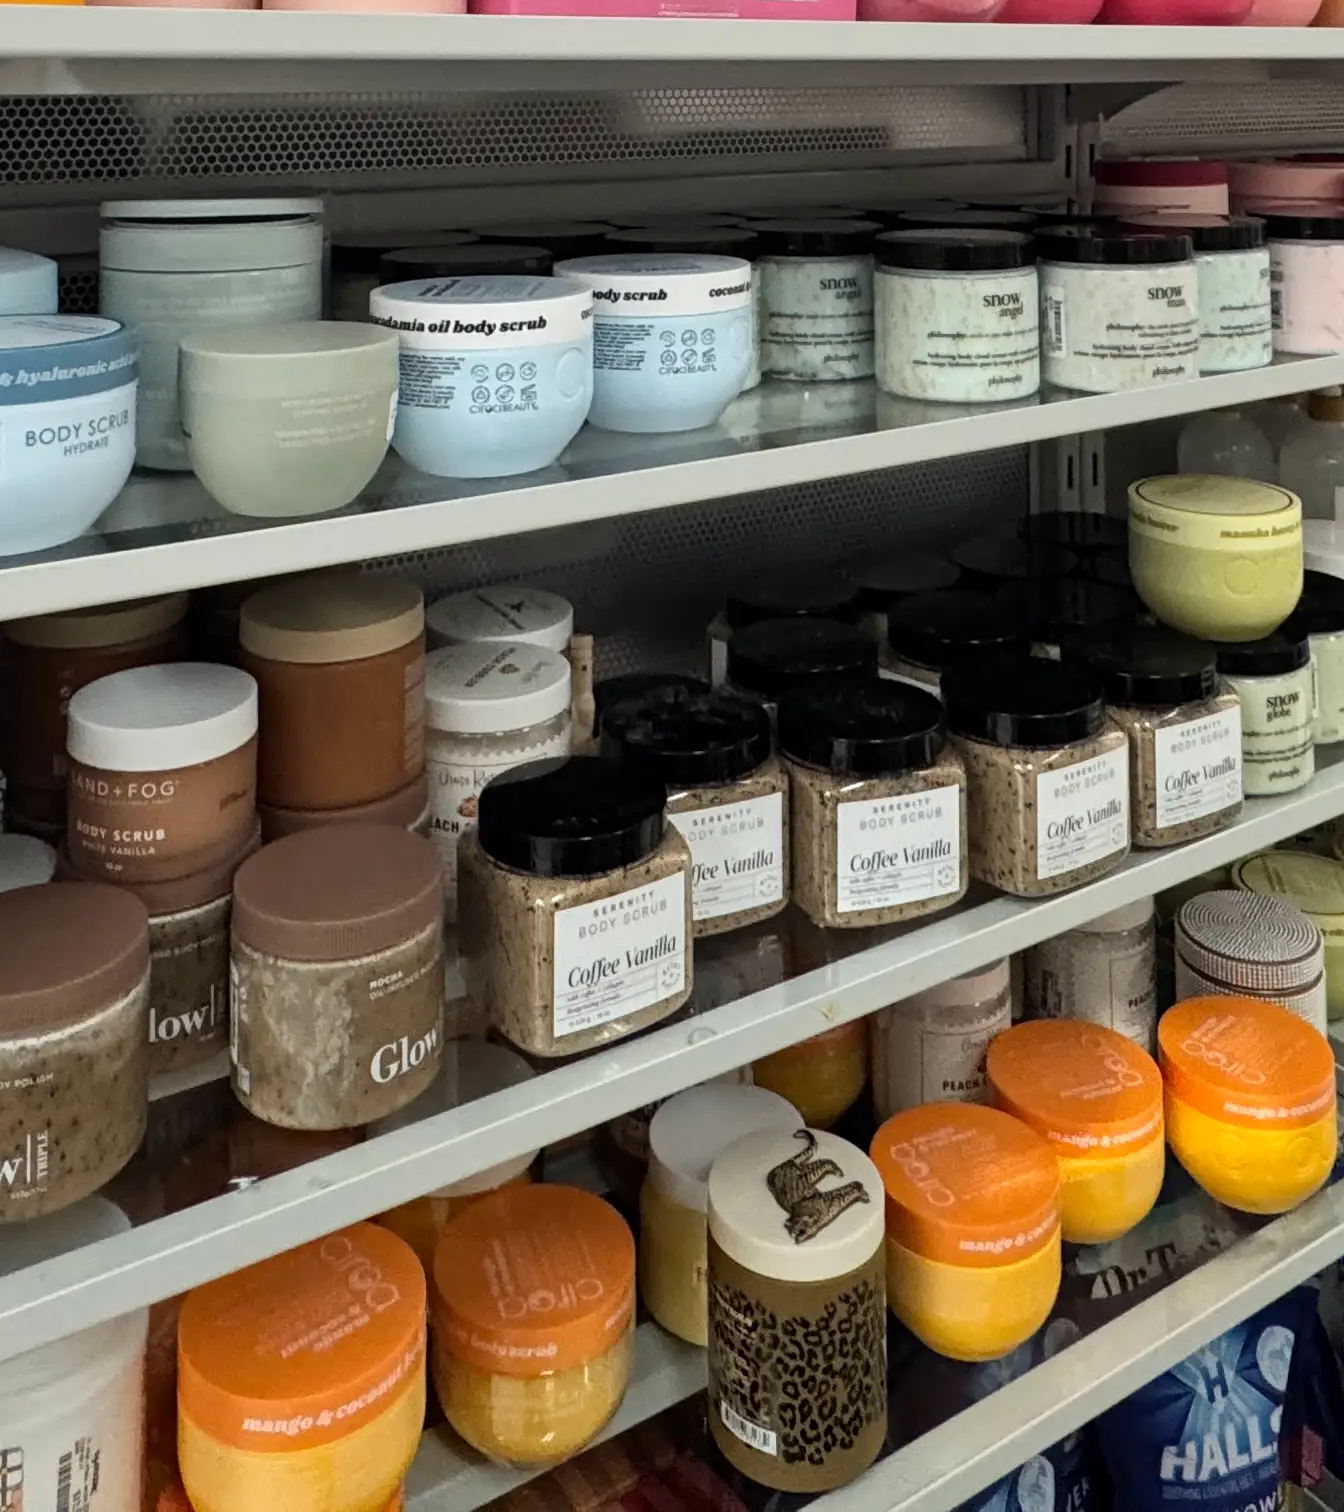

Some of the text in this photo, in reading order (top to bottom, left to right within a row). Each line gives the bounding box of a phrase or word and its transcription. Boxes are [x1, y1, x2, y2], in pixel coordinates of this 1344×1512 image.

[818, 276, 859, 292] snow
[1146, 285, 1186, 301] snow
[621, 287, 669, 304] scrub
[982, 291, 1023, 309] snow
[997, 303, 1025, 319] angel
[428, 315, 548, 337] oil body scrub
[15, 358, 109, 390] hyaluronic
[23, 408, 131, 449] BODY SCRUB
[62, 435, 111, 457] HYDRATE
[1266, 692, 1301, 711] snow
[1265, 706, 1294, 723] globe
[1163, 755, 1237, 794] Coffee Vanilla
[127, 779, 176, 798] FOG
[871, 797, 932, 815] SERENITY
[858, 815, 895, 830] BODY
[1046, 796, 1123, 843] Coffee Vanilla
[113, 827, 167, 842] SCRUB
[109, 843, 157, 856] VANILLA
[849, 838, 953, 874] Coffee Vanilla
[723, 847, 775, 878] Vanilla
[591, 890, 656, 919] SERENITY
[577, 917, 618, 940] BODY
[567, 933, 678, 991] Coffee Vanilla
[369, 969, 404, 990] MOCHA
[369, 1030, 438, 1085] Glow
[942, 1078, 981, 1092] PEACH
[1222, 1099, 1273, 1118] mango
[1047, 1129, 1101, 1149] mango
[35, 1129, 50, 1180] TRIPLE
[958, 1232, 1014, 1255] mango
[241, 1372, 404, 1436] mango & coconut
[1159, 1418, 1279, 1483] HALL
